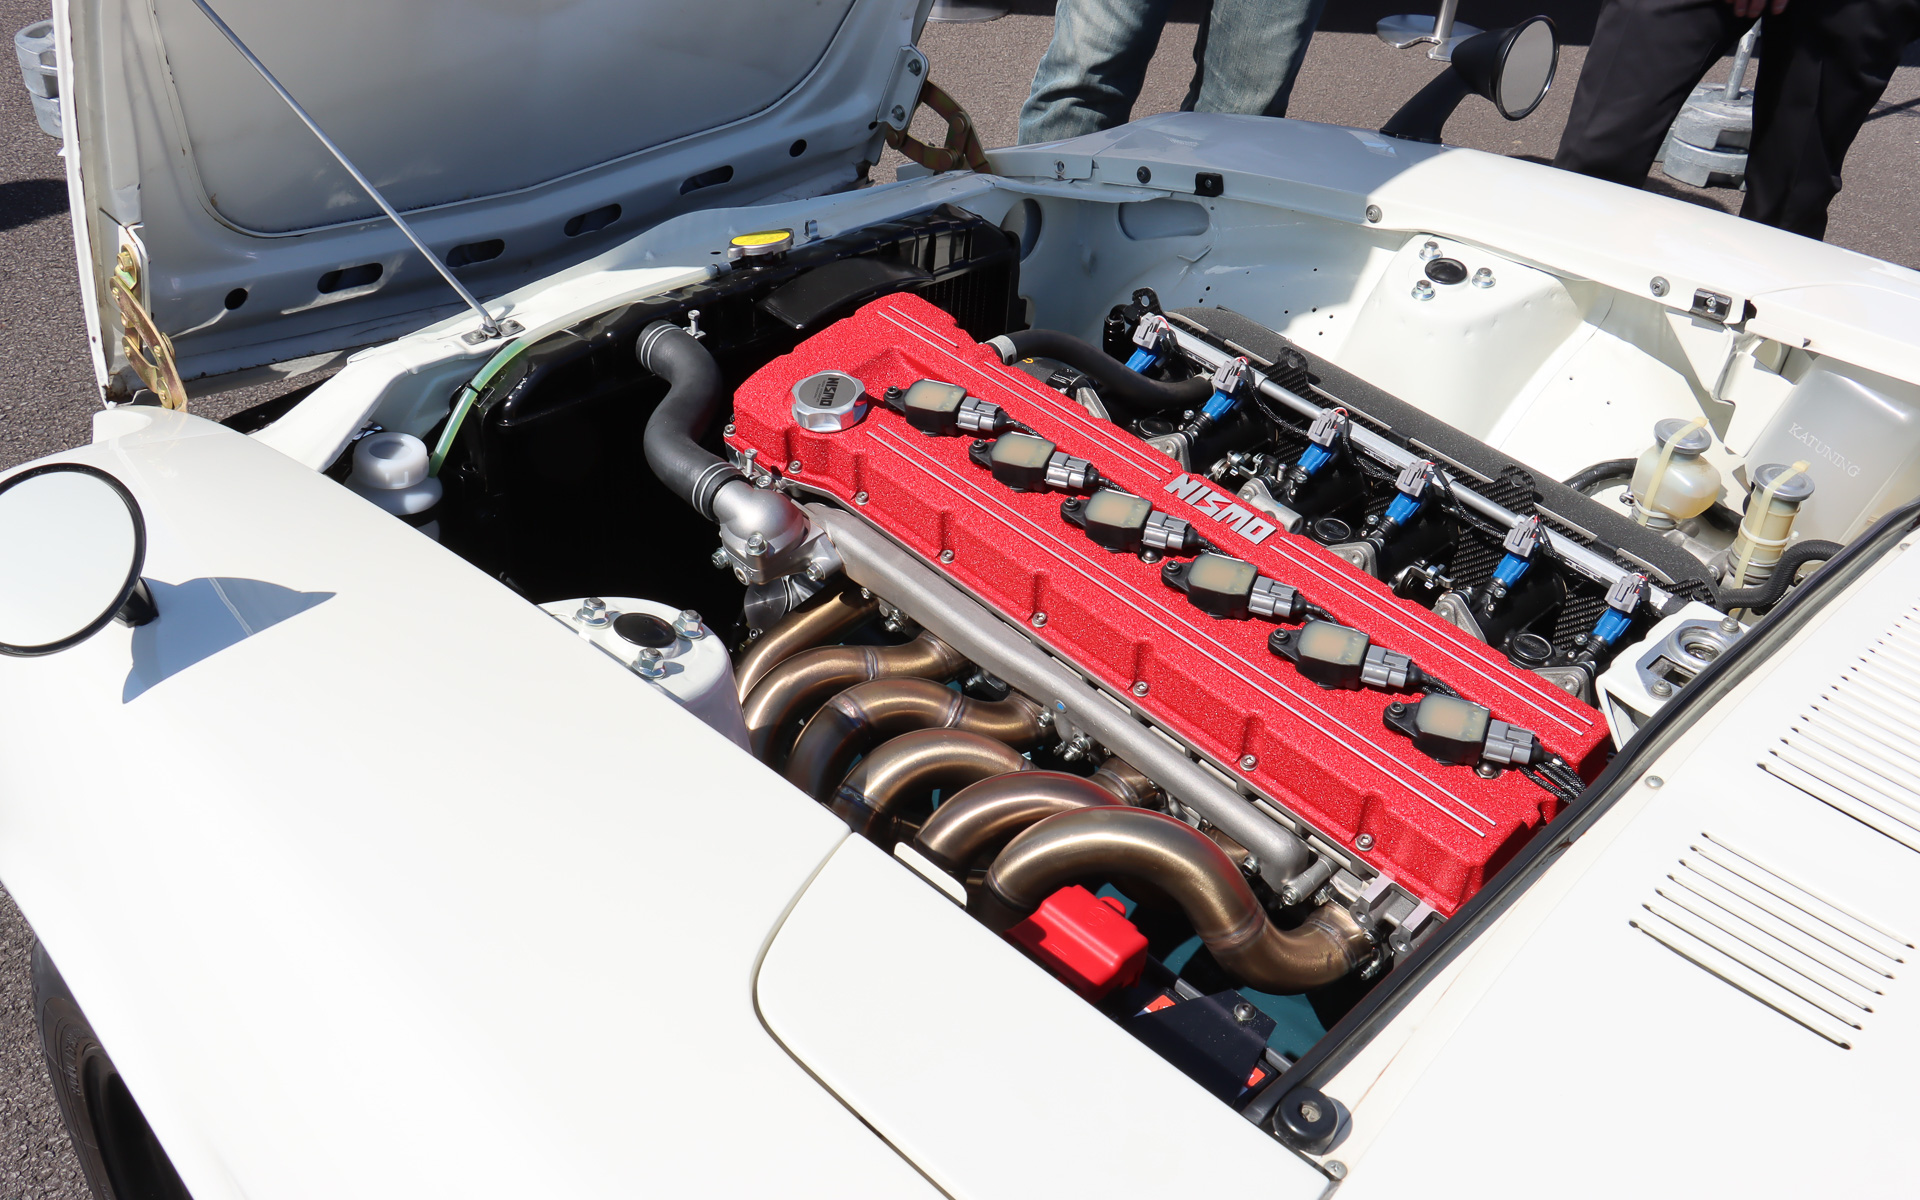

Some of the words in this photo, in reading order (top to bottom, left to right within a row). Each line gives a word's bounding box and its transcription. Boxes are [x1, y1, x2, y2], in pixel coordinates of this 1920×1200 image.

[819, 377, 840, 407] NISMO
[1788, 422, 1861, 477] KATUNING
[1163, 473, 1277, 546] NISMO
